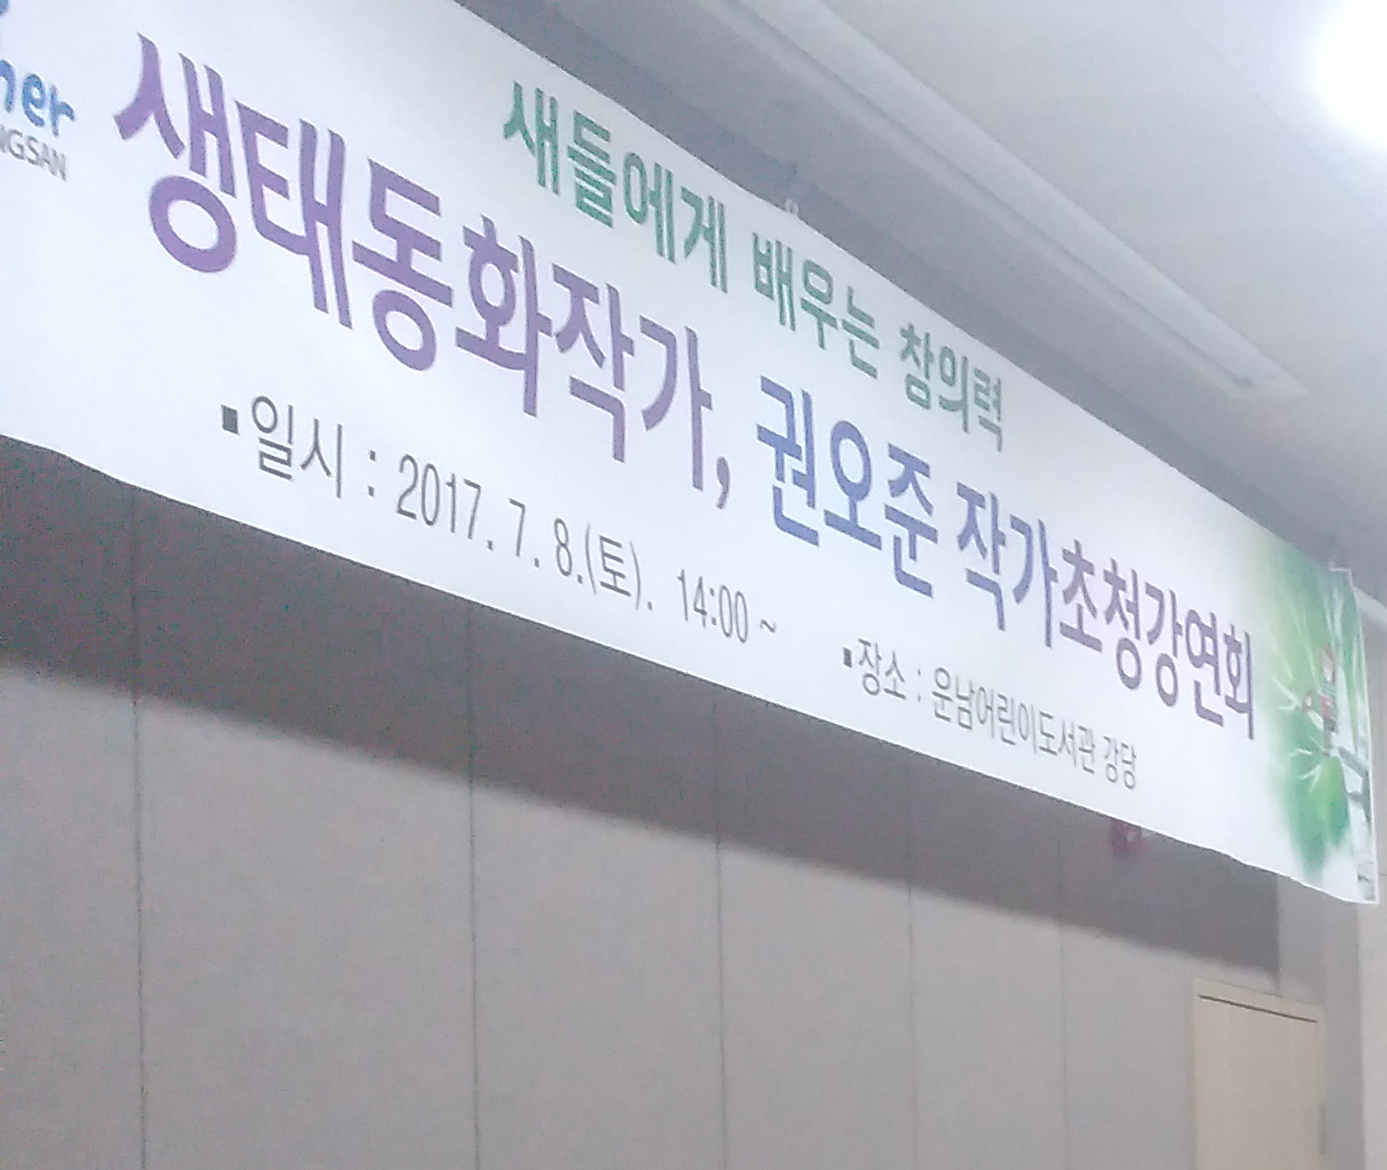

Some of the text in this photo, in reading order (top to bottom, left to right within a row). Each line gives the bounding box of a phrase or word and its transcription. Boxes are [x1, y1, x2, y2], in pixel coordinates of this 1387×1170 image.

[114, 32, 732, 510] 생태동화작가,
[756, 375, 940, 600] 권오준
[503, 81, 729, 294] 새들에게
[752, 232, 880, 380] 배우는
[251, 395, 342, 499] 일시
[857, 636, 907, 701] 장소
[931, 666, 1097, 775] 운남어린이도서관
[1103, 734, 1138, 790] 강당
